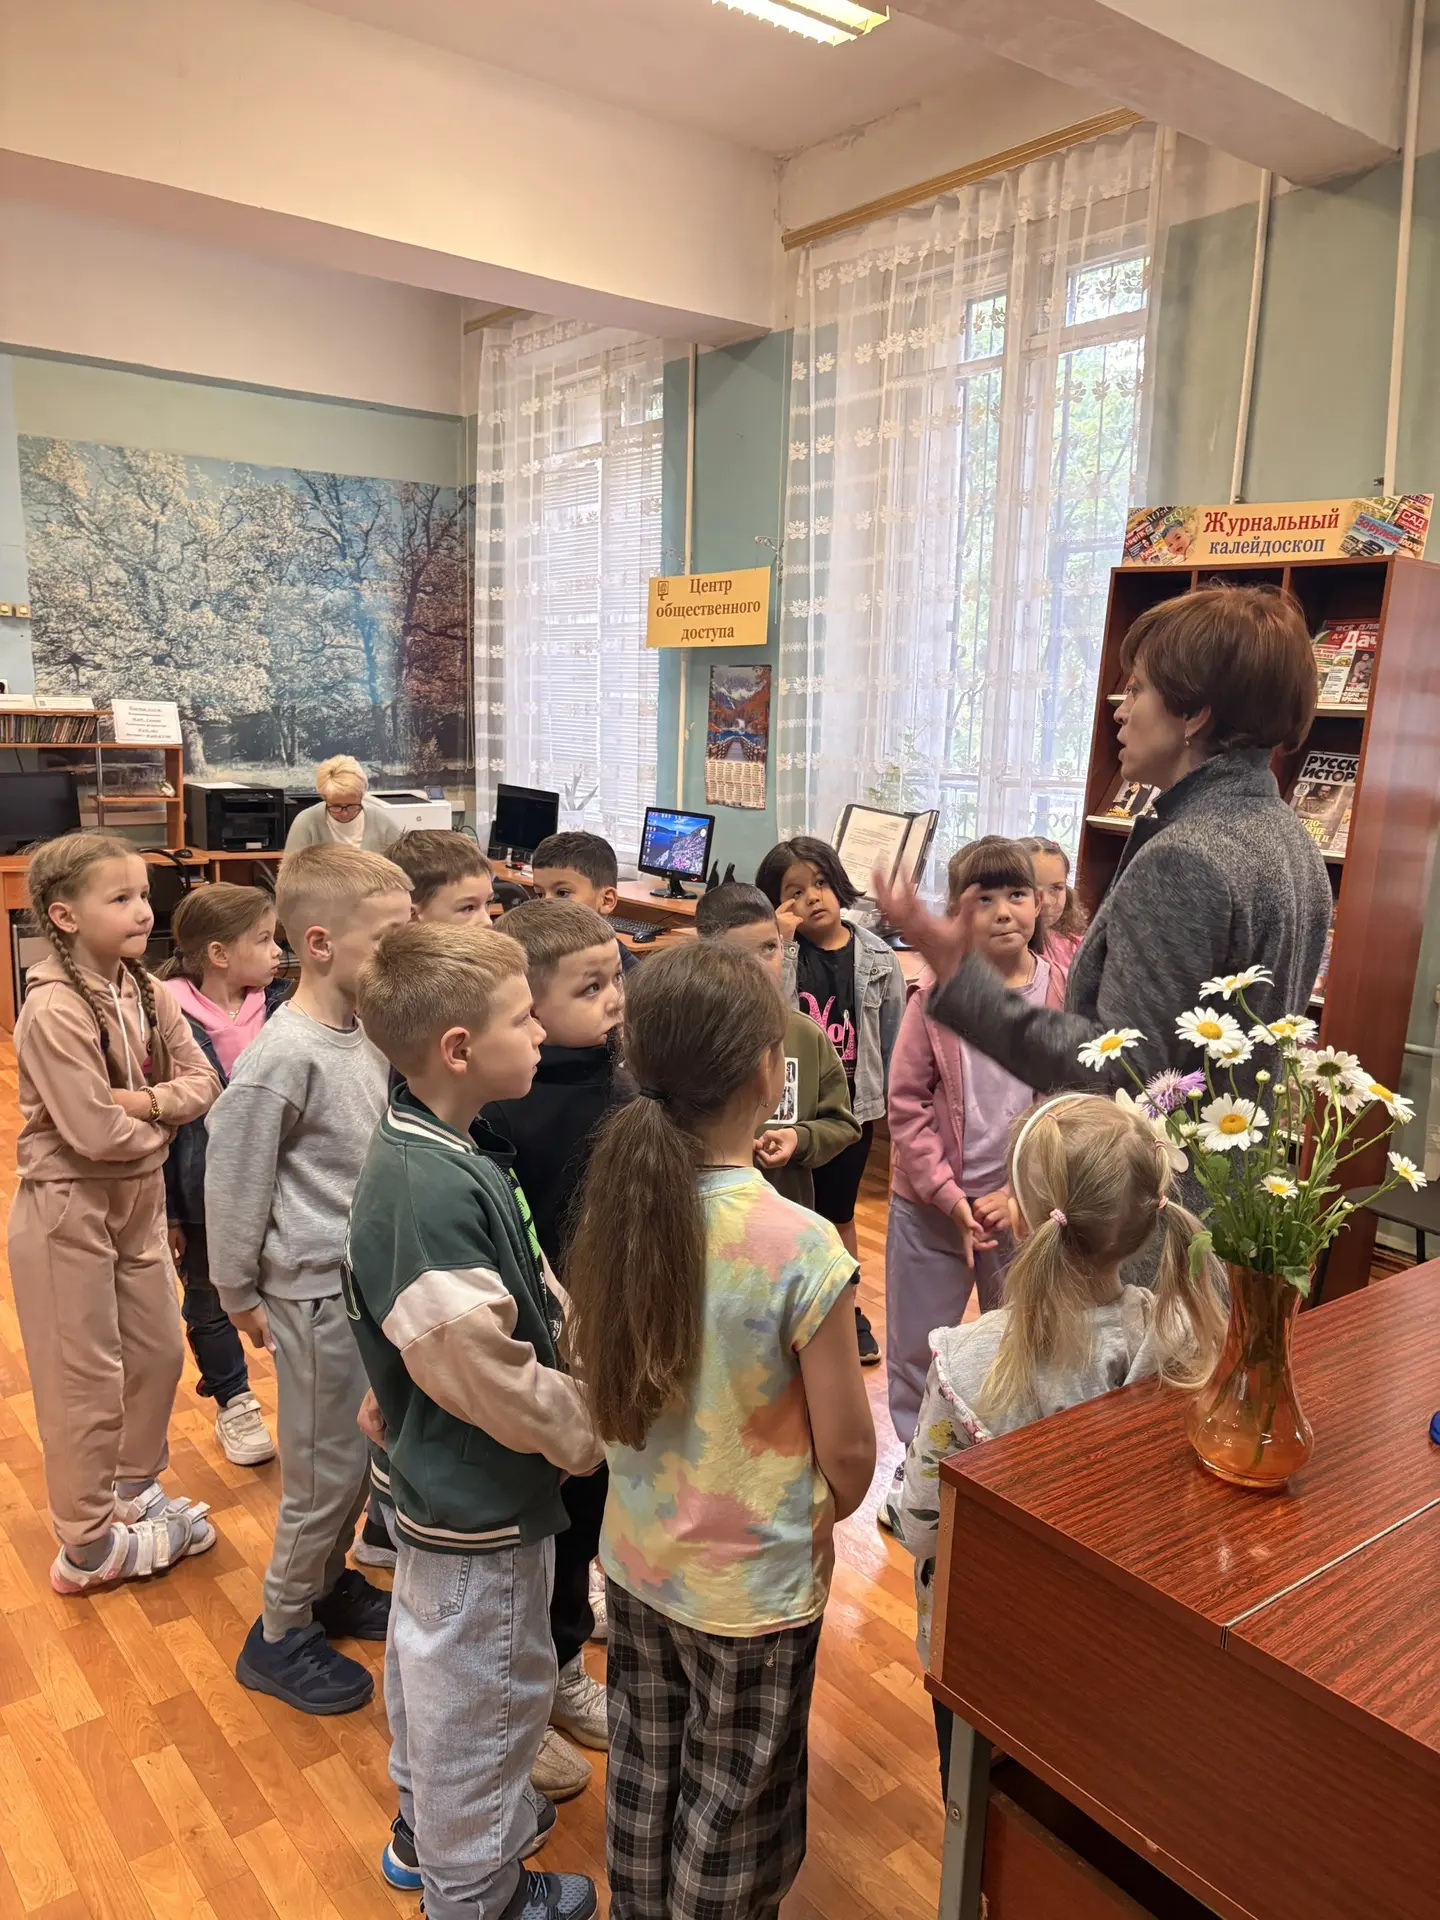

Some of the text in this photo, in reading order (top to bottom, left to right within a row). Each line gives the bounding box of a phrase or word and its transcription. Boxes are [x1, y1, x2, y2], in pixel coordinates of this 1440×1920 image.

[1203, 508, 1340, 536] Журнальный
[1401, 510, 1425, 528] САД
[1209, 536, 1326, 556] калейдоскоп
[689, 579, 732, 595] Центр
[656, 600, 761, 618] общественного
[681, 626, 735, 642] доступа
[1306, 756, 1358, 771] РУССК
[1302, 767, 1356, 782] ИСТОР
